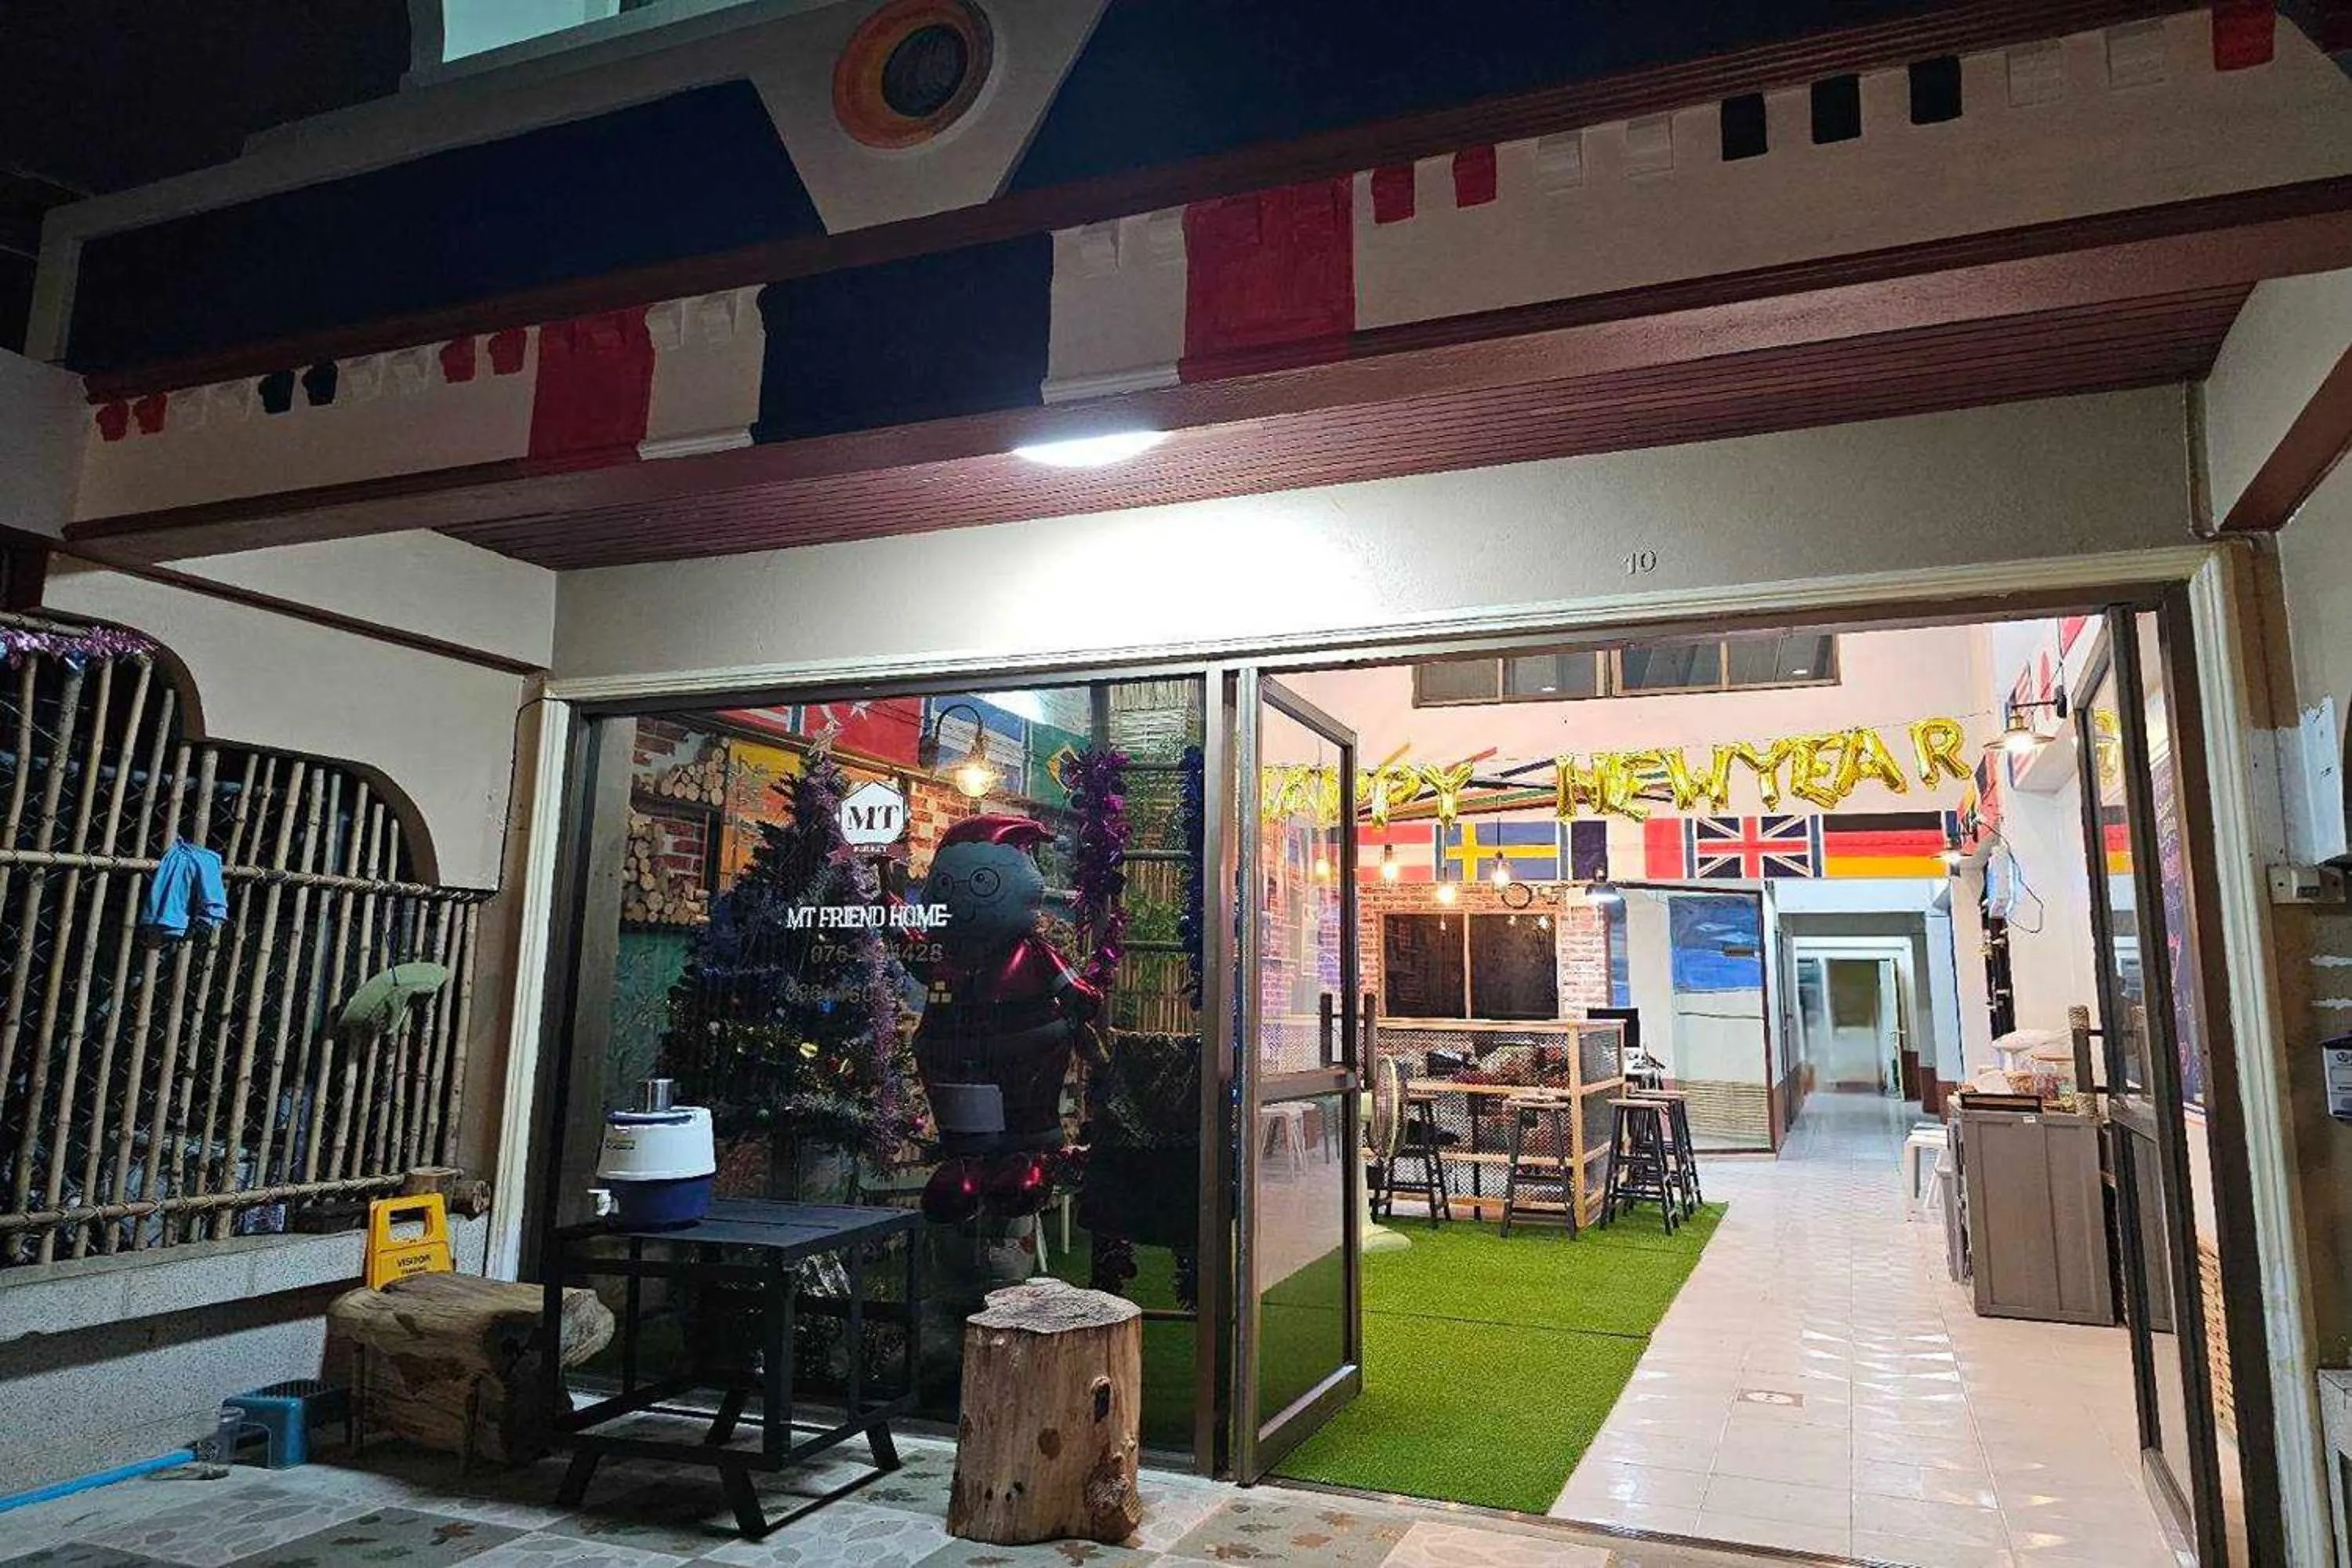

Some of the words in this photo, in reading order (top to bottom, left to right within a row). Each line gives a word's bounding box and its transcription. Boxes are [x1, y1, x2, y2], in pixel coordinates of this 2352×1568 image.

[1622, 549, 1657, 574] 10
[848, 805, 899, 830] MT
[786, 907, 816, 930] MT
[818, 905, 886, 928] FRIEND
[889, 904, 953, 931] HOME
[810, 942, 944, 964] 076-428
